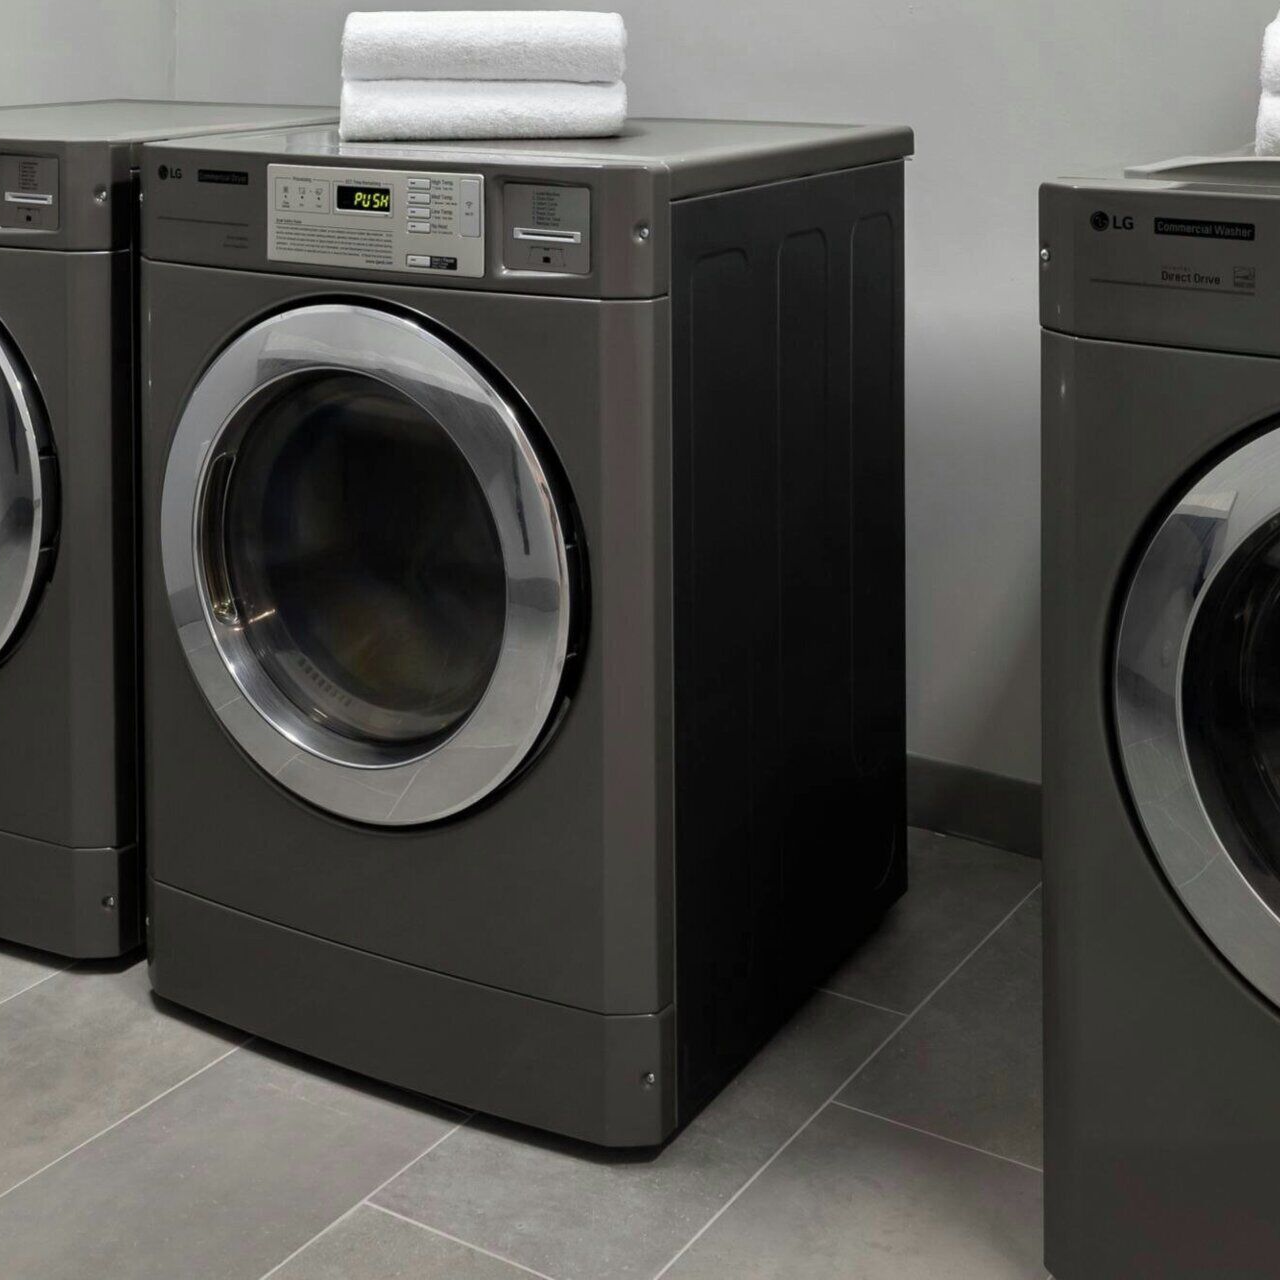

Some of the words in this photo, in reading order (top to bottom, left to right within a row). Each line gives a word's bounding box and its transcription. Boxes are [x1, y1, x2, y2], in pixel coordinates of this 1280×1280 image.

[169, 168, 183, 179] LG
[354, 192, 389, 209] PUSH
[1113, 216, 1134, 230] LG
[1157, 221, 1212, 235] Commercial
[1214, 225, 1252, 238] Washer
[1162, 270, 1191, 282] Direct
[1194, 273, 1221, 285] Drive
